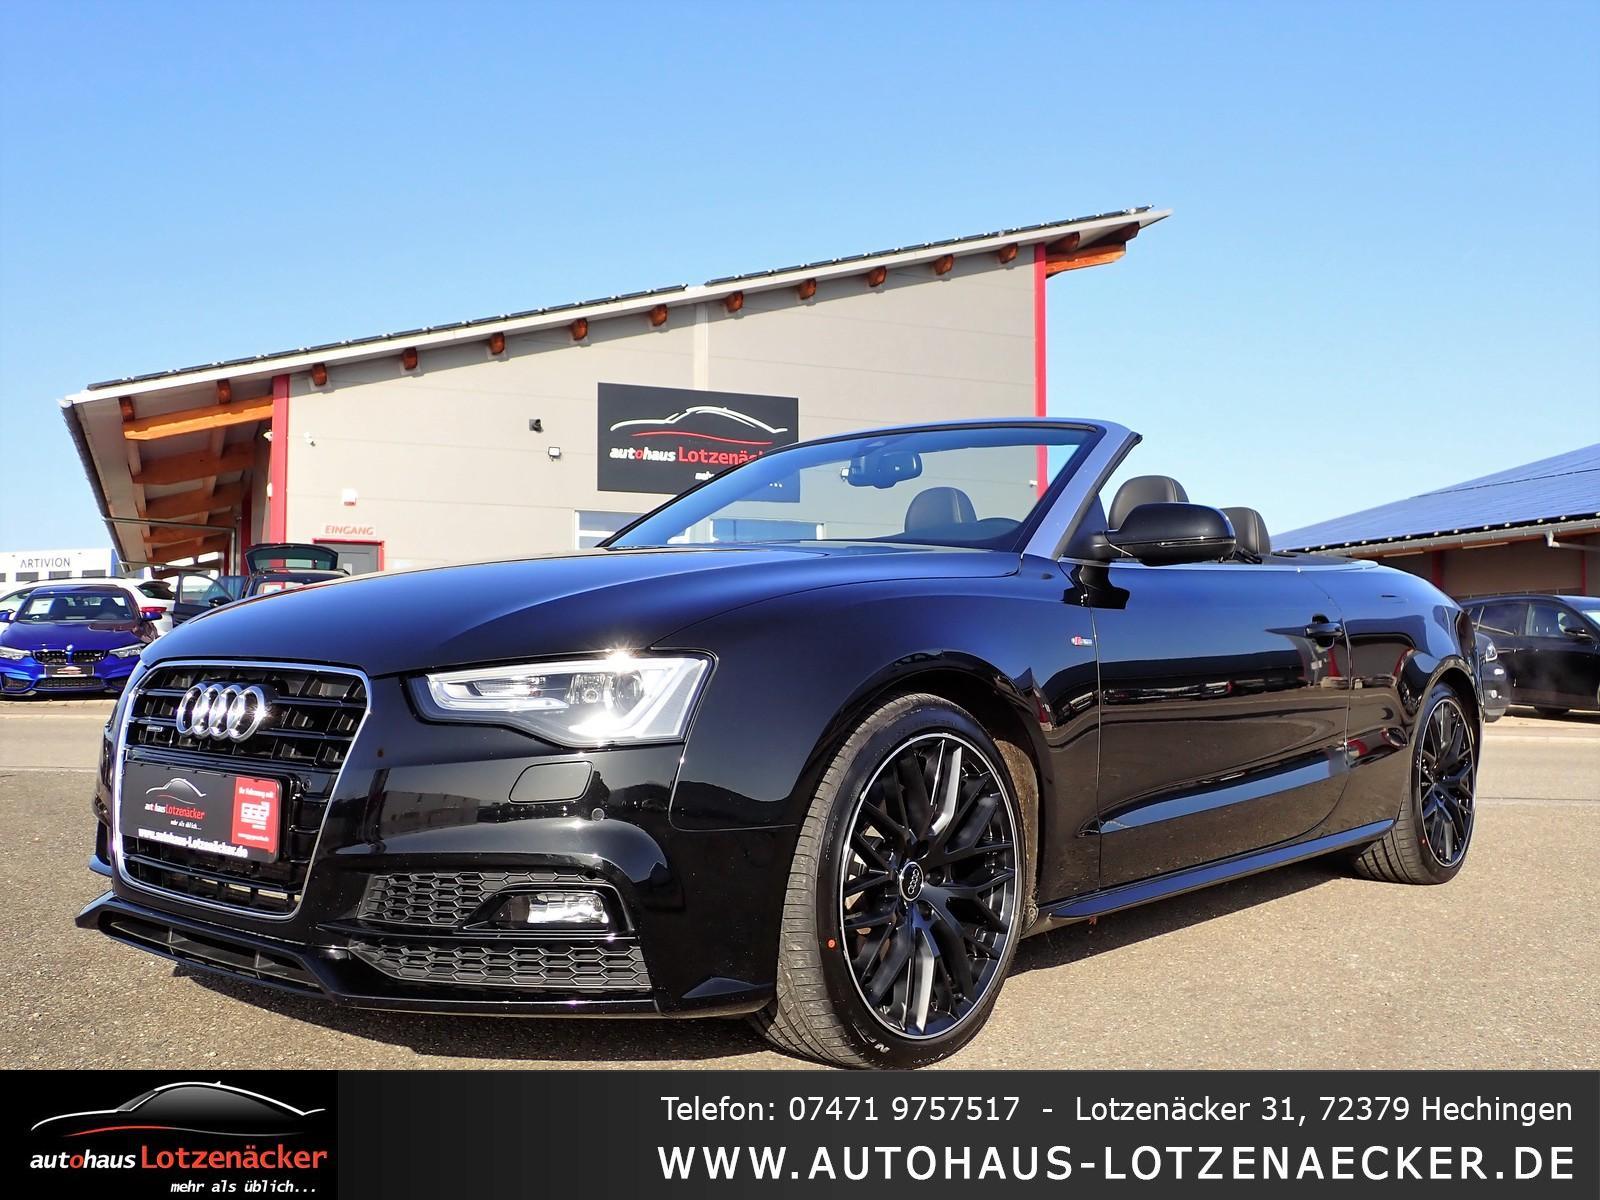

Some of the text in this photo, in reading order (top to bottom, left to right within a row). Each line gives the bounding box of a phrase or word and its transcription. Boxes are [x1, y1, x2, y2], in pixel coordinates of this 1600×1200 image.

[609, 446, 676, 462] autohaus
[324, 525, 375, 535] EINGANG
[20, 557, 71, 568] ARTIVION
